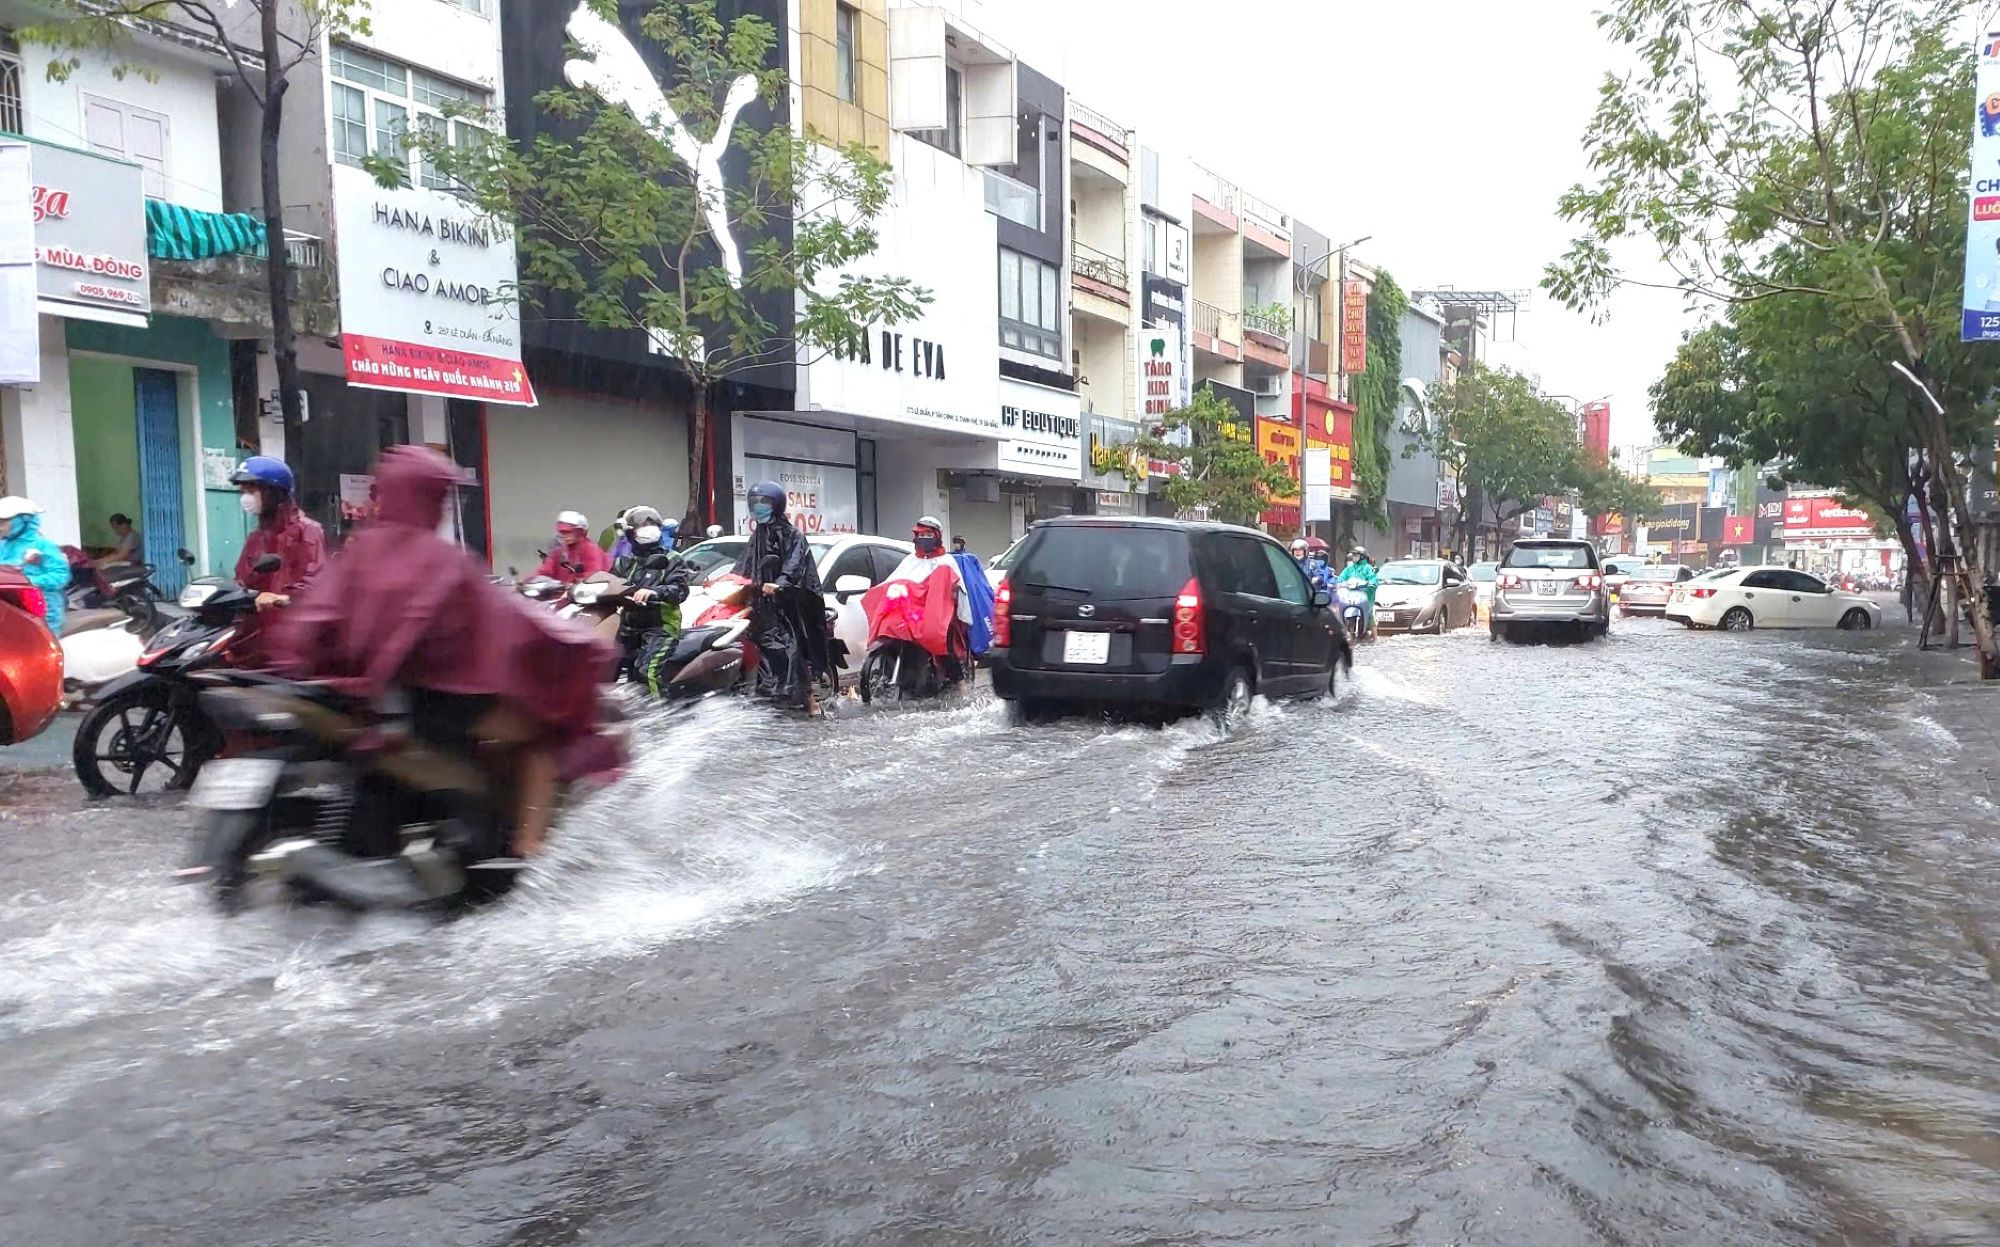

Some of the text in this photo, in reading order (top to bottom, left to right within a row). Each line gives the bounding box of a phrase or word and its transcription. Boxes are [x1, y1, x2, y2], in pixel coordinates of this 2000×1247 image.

[375, 201, 490, 248] HANA BIKINI
[47, 247, 87, 269] MÙA
[93, 256, 143, 278] ĐÔNG
[430, 249, 441, 264] &
[383, 267, 490, 305] CIAO AMOR
[1980, 316, 2000, 328] 125
[882, 331, 904, 373] DE
[913, 337, 946, 380] EVA
[352, 358, 380, 374] CHÀO
[381, 363, 411, 379] MỪNG
[413, 366, 441, 383] NGÀY
[442, 368, 468, 386] QUỐC
[1147, 381, 1169, 396] KIM
[1002, 405, 1081, 439] HP BOUTIQUE
[788, 491, 816, 509] SALE
